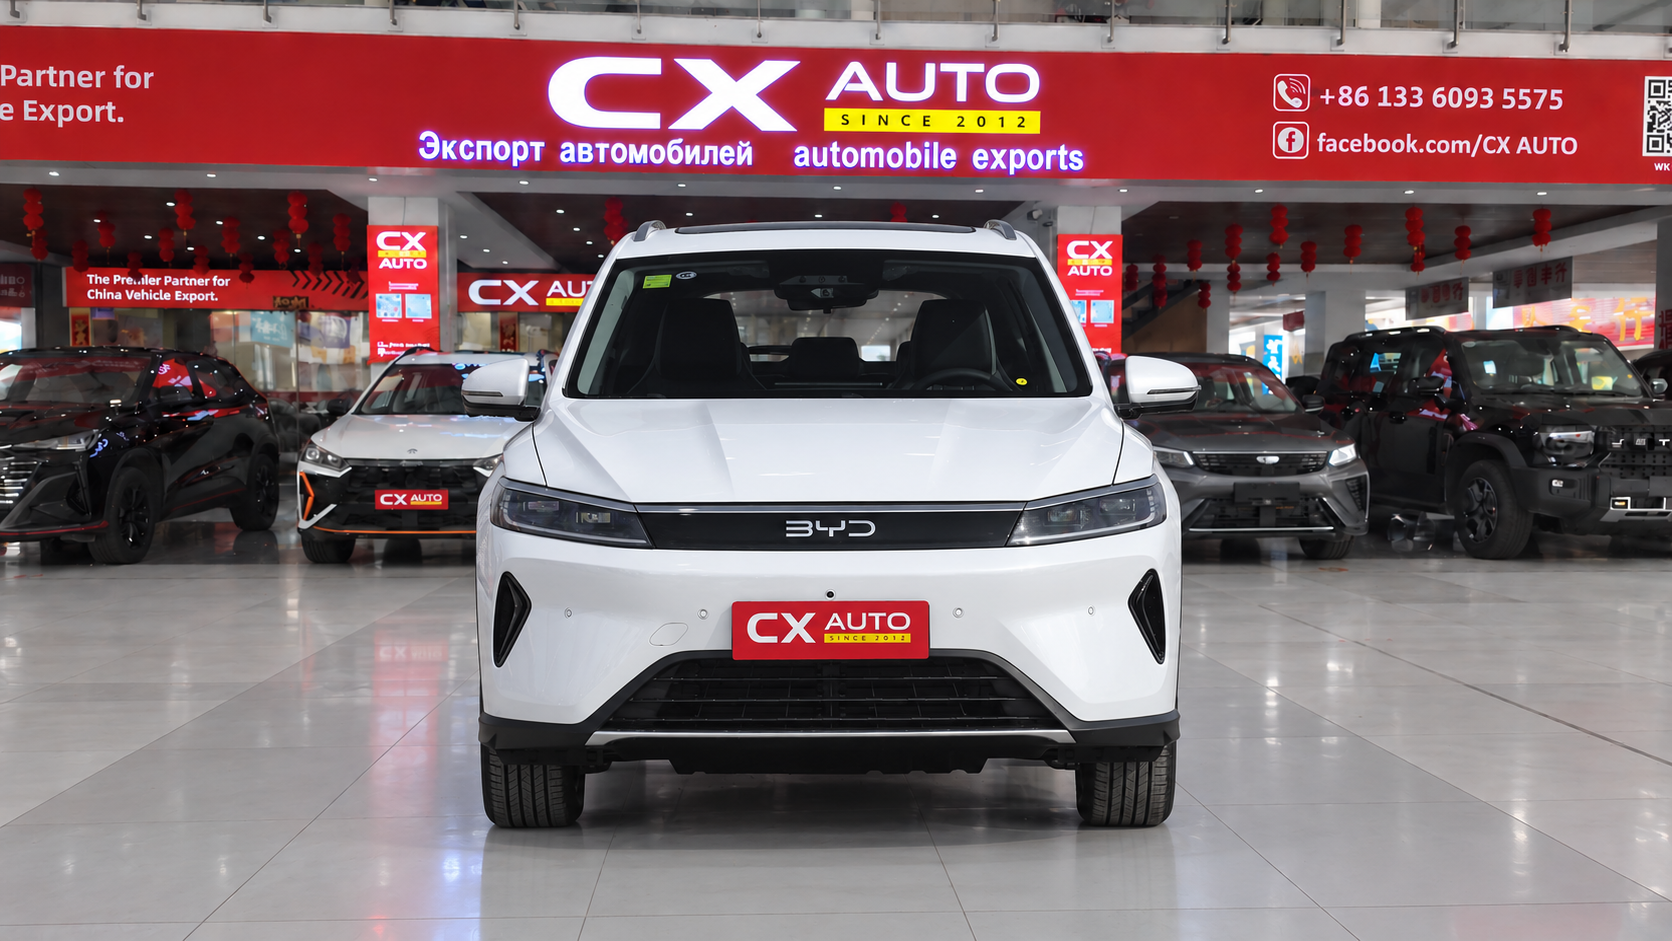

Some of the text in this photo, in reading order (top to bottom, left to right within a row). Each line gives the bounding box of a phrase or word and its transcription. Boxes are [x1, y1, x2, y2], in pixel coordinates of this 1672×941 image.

[0, 64, 154, 89] Partner for
[548, 57, 1040, 131] CX AUTO
[1319, 86, 1564, 110] +86 133 6093 5575
[23, 100, 124, 128] Export.
[840, 114, 1028, 128] SINCE 2012
[418, 131, 753, 168] Экспорт автомобилей
[1317, 132, 1579, 158] facebook.com/CX AUTO
[793, 141, 1085, 176] automobile exports
[376, 231, 426, 251] CX
[1067, 240, 1113, 259] CX
[378, 258, 427, 269] AUTO
[1067, 265, 1113, 276] AUTO
[87, 274, 110, 285] The
[164, 275, 210, 286] Partner
[212, 275, 231, 287] for
[87, 289, 219, 303] China Vehicle Export.
[468, 279, 593, 306] CX AU
[380, 493, 442, 505] CX AUTO
[786, 520, 876, 537] BYD
[746, 612, 911, 644] CX AUTO
